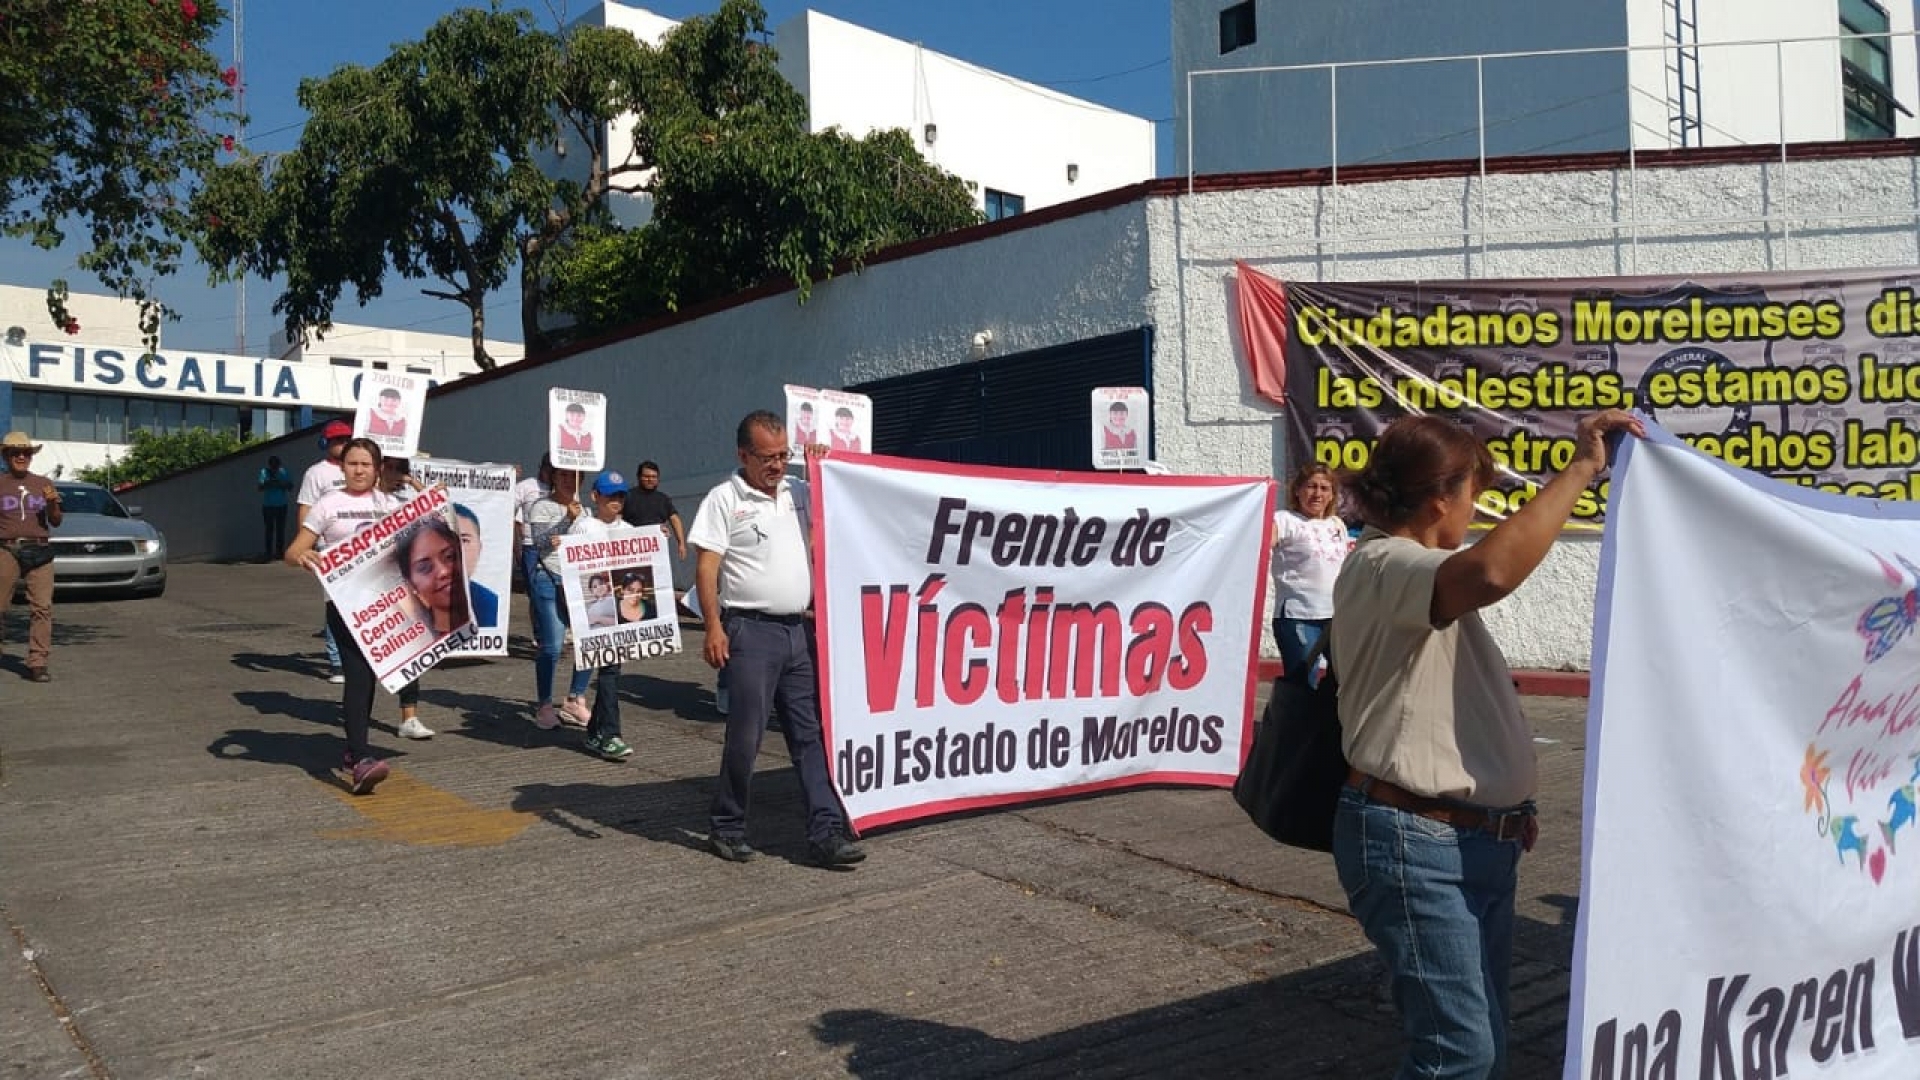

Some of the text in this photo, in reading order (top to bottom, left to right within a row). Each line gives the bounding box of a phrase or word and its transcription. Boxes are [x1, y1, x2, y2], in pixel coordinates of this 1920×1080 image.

[1297, 304, 1560, 348] Ciudadanos
[1573, 297, 1842, 341] Morelenses
[29, 344, 301, 399] FISCALÍA
[1318, 367, 1383, 408] las
[1398, 364, 1634, 410] molestias,
[1650, 362, 1848, 405] estamos
[565, 536, 661, 563] DESAPARECIDA
[926, 496, 1172, 568] Frente de
[350, 584, 408, 629] Jessica
[360, 610, 406, 646] Cerón
[369, 620, 426, 664] Salinas
[400, 623, 479, 682] MORELO
[581, 638, 674, 668] MORELOS
[860, 573, 1214, 715] Víctimas
[837, 706, 1225, 797] del Estado de Morelos
[1591, 1008, 1683, 1080] Ana
[1699, 956, 1877, 1080] Karen
